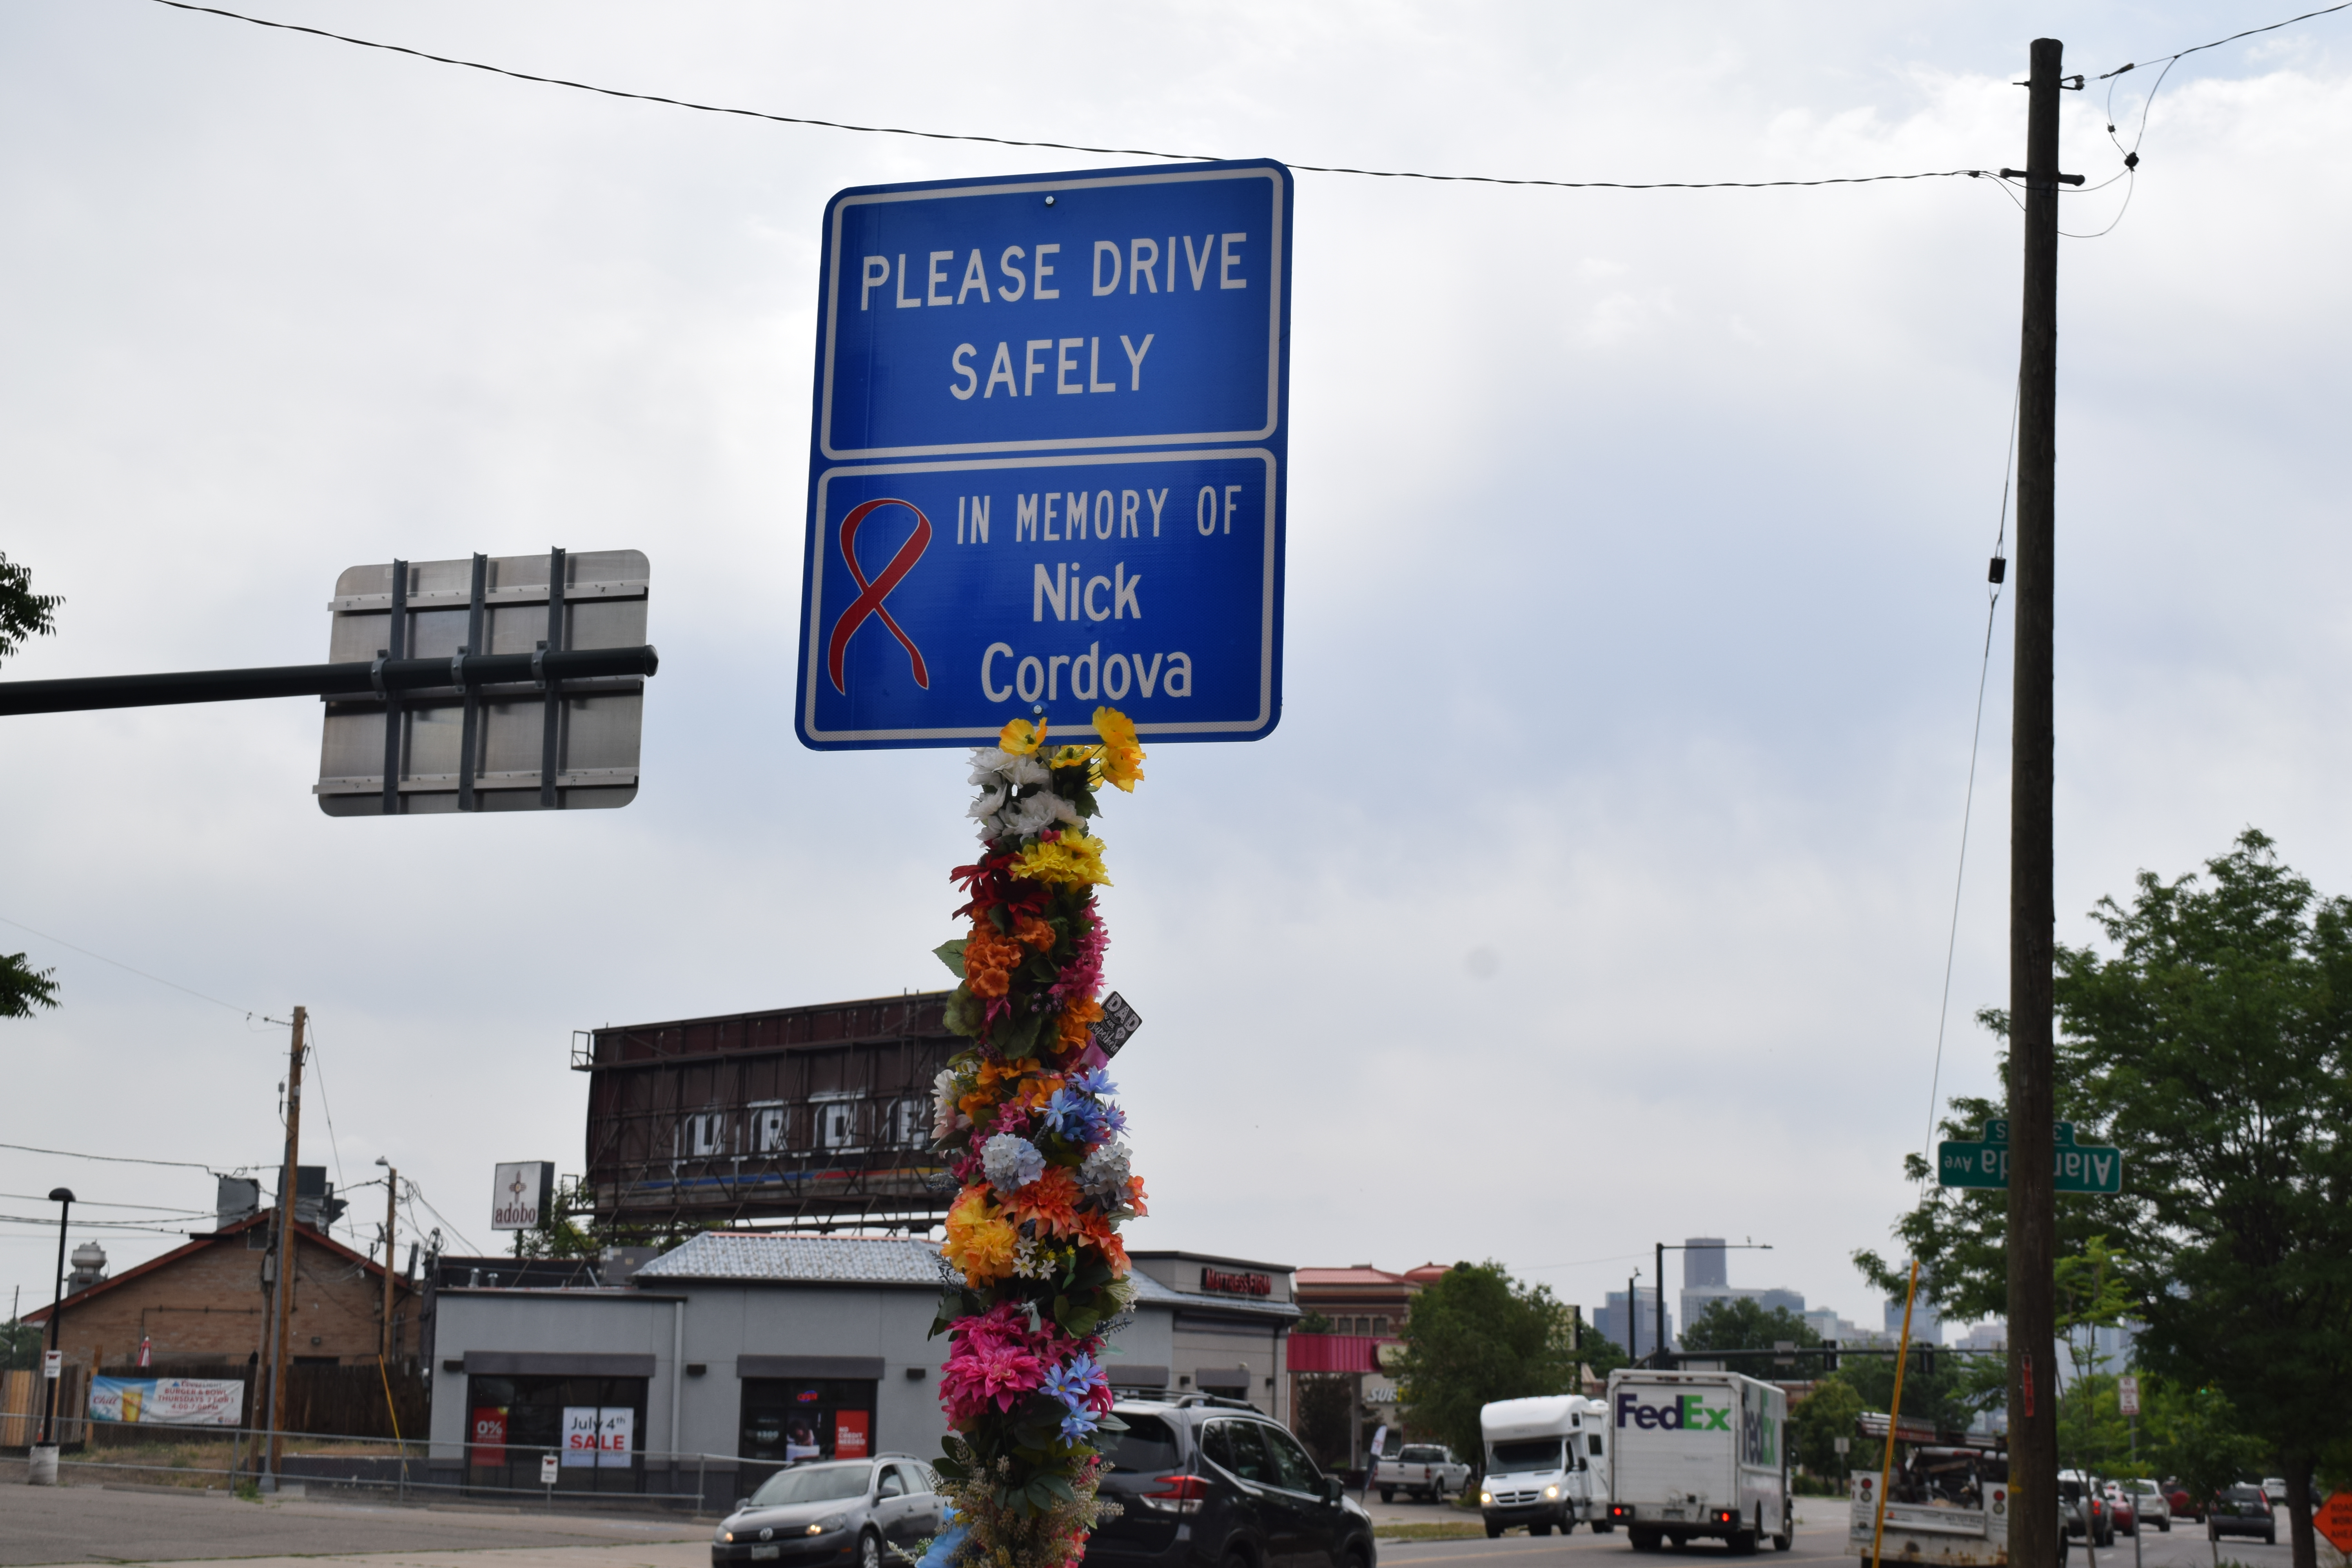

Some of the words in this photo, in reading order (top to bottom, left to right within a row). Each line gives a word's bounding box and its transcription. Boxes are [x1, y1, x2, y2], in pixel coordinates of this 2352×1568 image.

[861, 244, 1060, 311] PLEASE
[1093, 232, 1247, 296] DRIVE
[950, 334, 1155, 401] SAFELY
[957, 495, 990, 544] IN
[1016, 488, 1169, 542] MEMORY
[1197, 486, 1242, 535] OF
[1033, 562, 1142, 622] Nick
[981, 641, 1192, 702] Cordova
[1106, 993, 1139, 1031] DAD
[1106, 1020, 1116, 1029] ARE
[1088, 1022, 1119, 1053] Superhero
[1117, 1029, 1125, 1038] MY
[1995, 1122, 2006, 1139] S
[1944, 1155, 1973, 1173] Ave
[1981, 1149, 2112, 1187] Alada
[496, 1202, 536, 1223] adobo
[477, 1420, 503, 1434] 0%
[571, 1416, 603, 1434] July
[606, 1415, 626, 1429] 4th
[1617, 1393, 1731, 1431] FedEx
[570, 1433, 624, 1450] SALE
